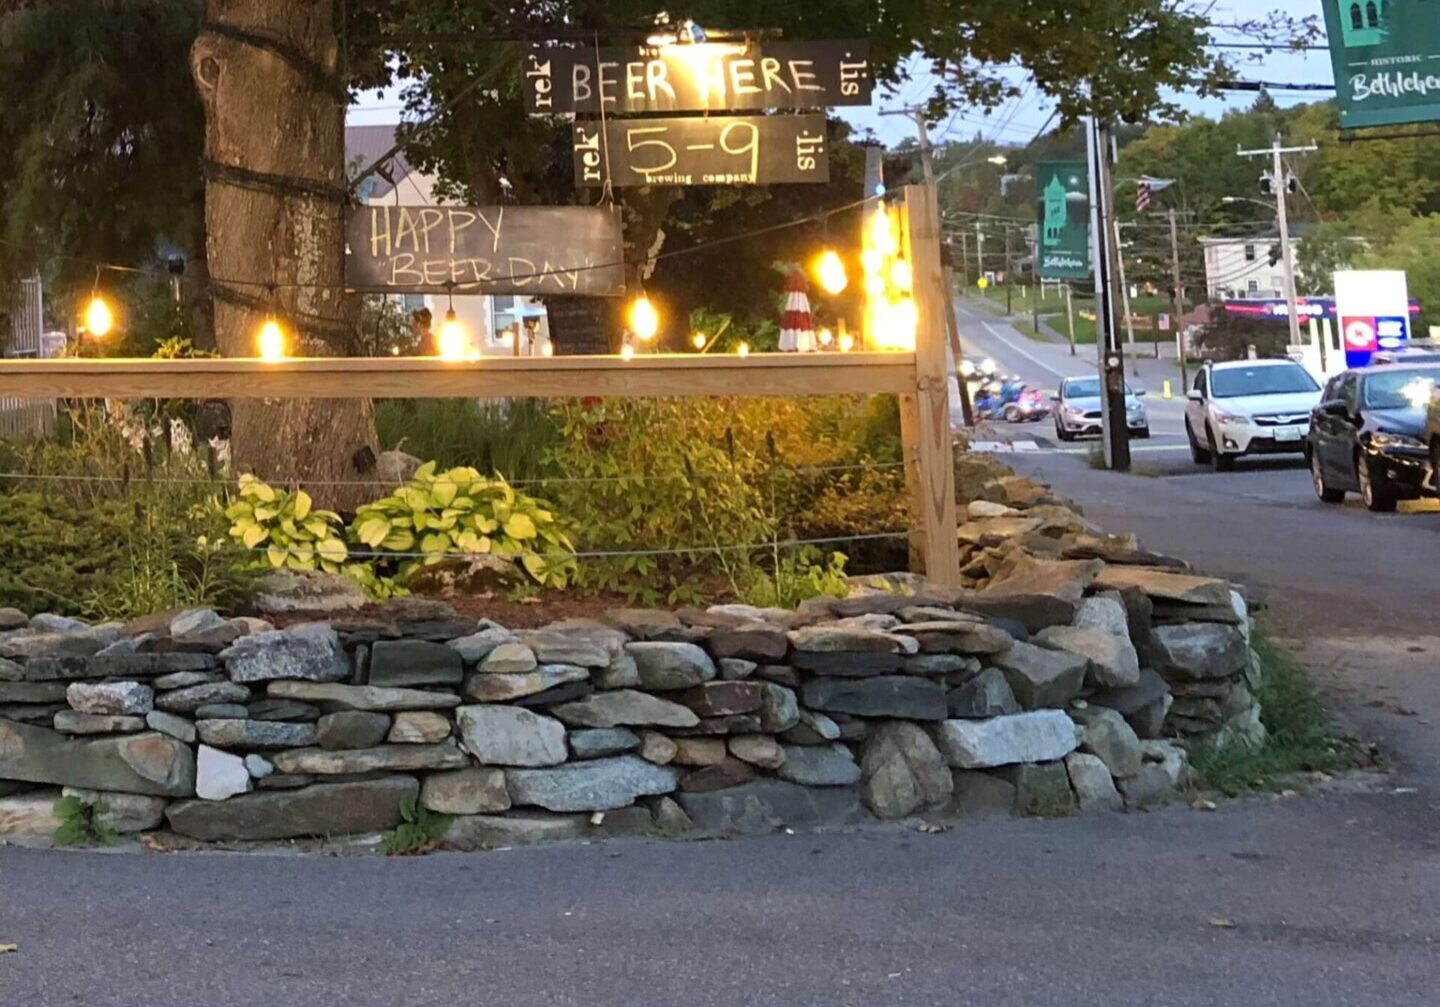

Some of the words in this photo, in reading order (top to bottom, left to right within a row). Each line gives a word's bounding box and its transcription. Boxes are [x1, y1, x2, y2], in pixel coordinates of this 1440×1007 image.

[1371, 54, 1423, 66] HISTORIC
[572, 59, 676, 102] BEER
[698, 58, 826, 99] HERE
[1348, 71, 1440, 101] Bethlehe
[645, 172, 692, 185] brewing
[702, 173, 755, 185] company
[370, 205, 503, 257] HAPPY
